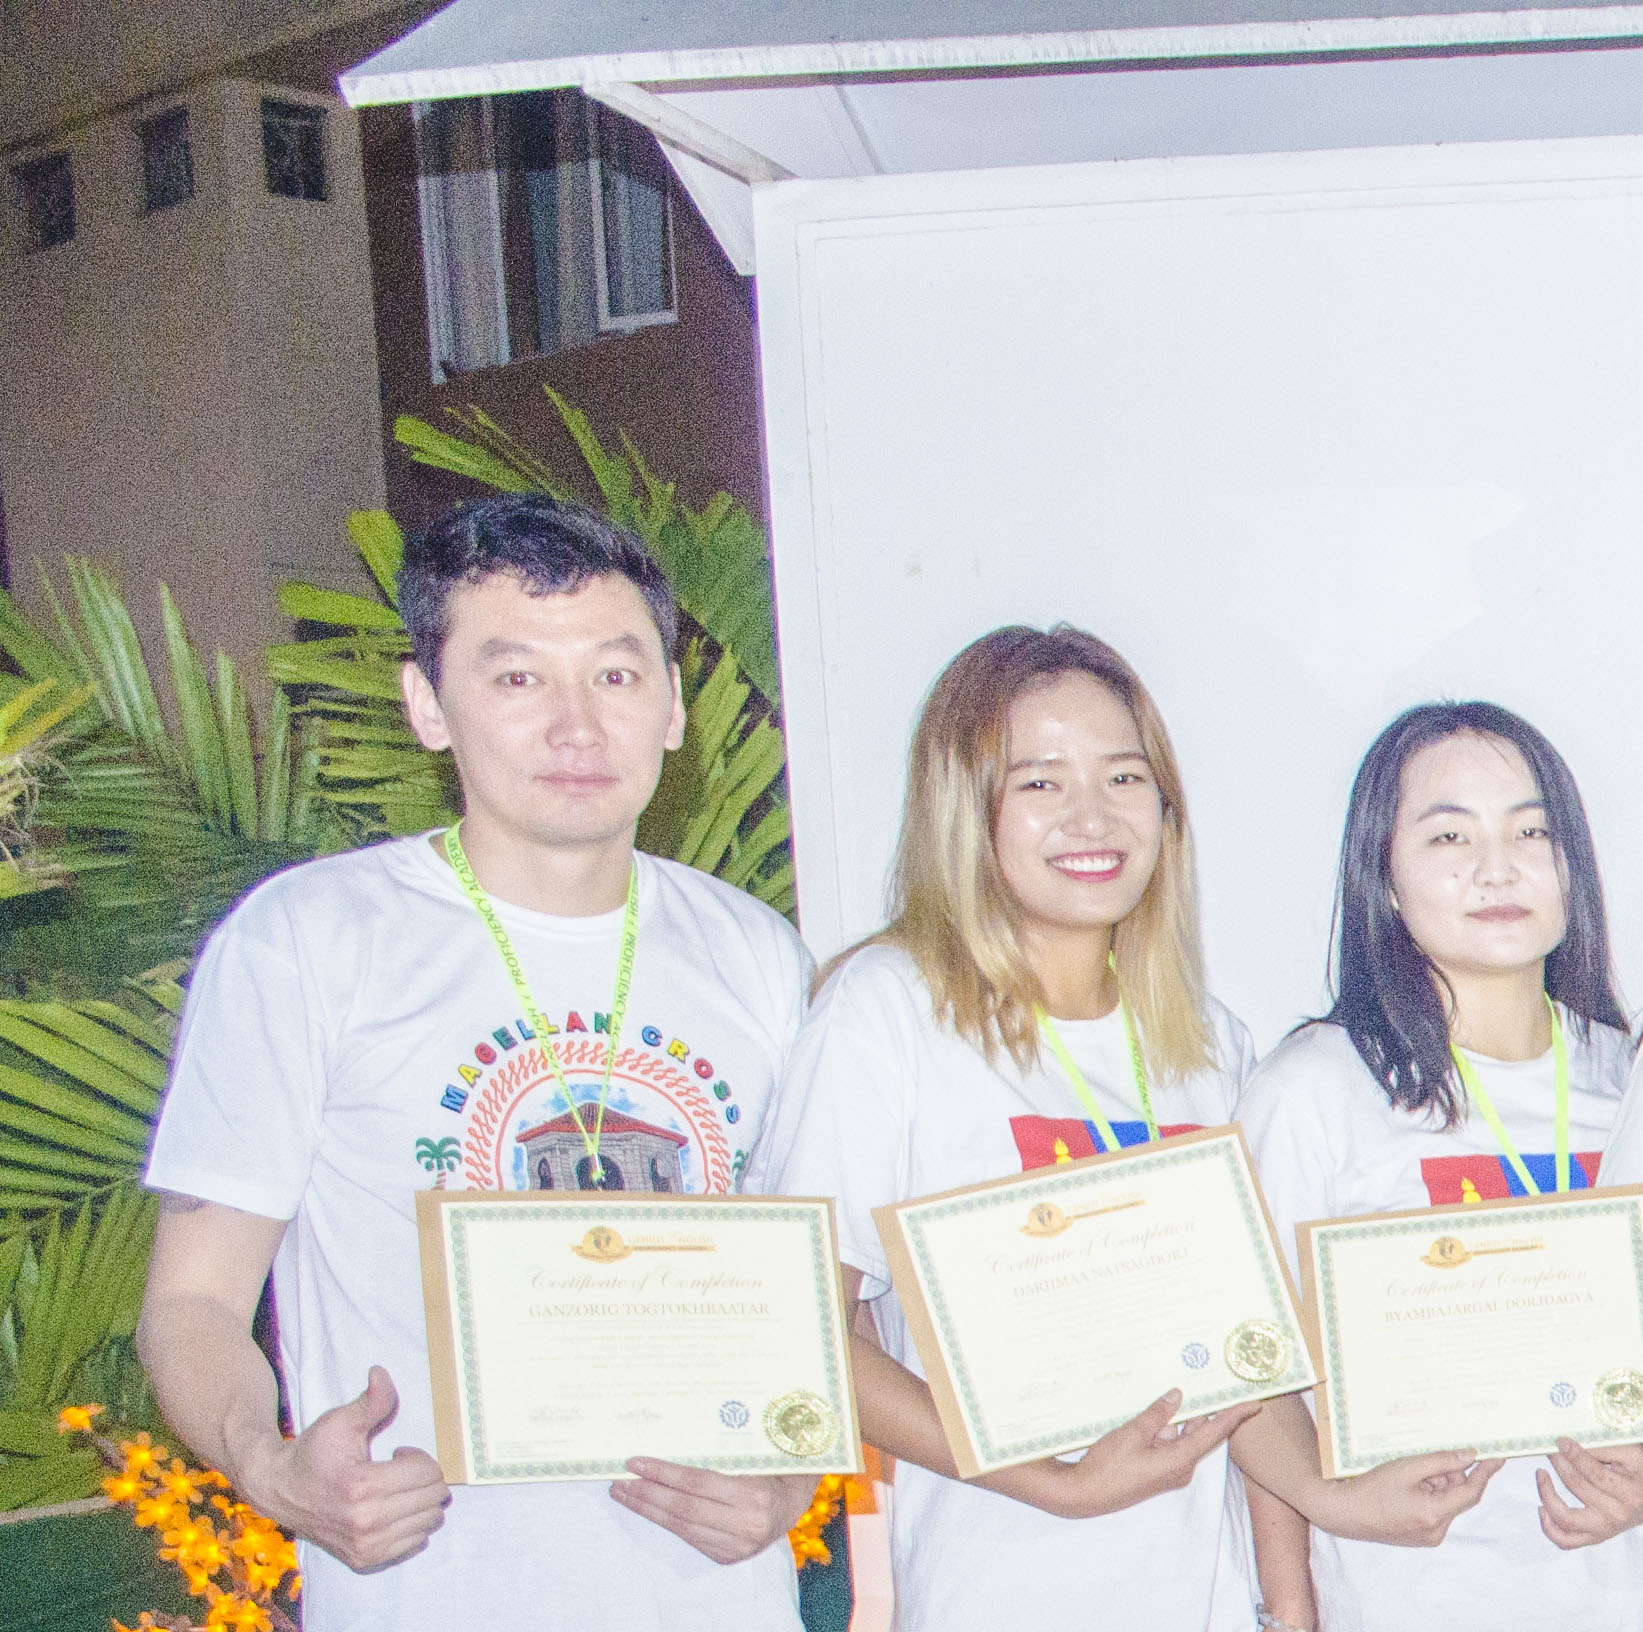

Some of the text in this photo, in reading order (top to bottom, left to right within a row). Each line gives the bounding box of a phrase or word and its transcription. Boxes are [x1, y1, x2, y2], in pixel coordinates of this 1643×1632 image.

[475, 893, 527, 987] PROFICIENCY
[617, 931, 636, 1018] PROFICIENCY
[641, 1025, 742, 1124] CROSS
[525, 1264, 765, 1292] Certificate of Completion
[528, 1303, 620, 1318] GANZORIG
